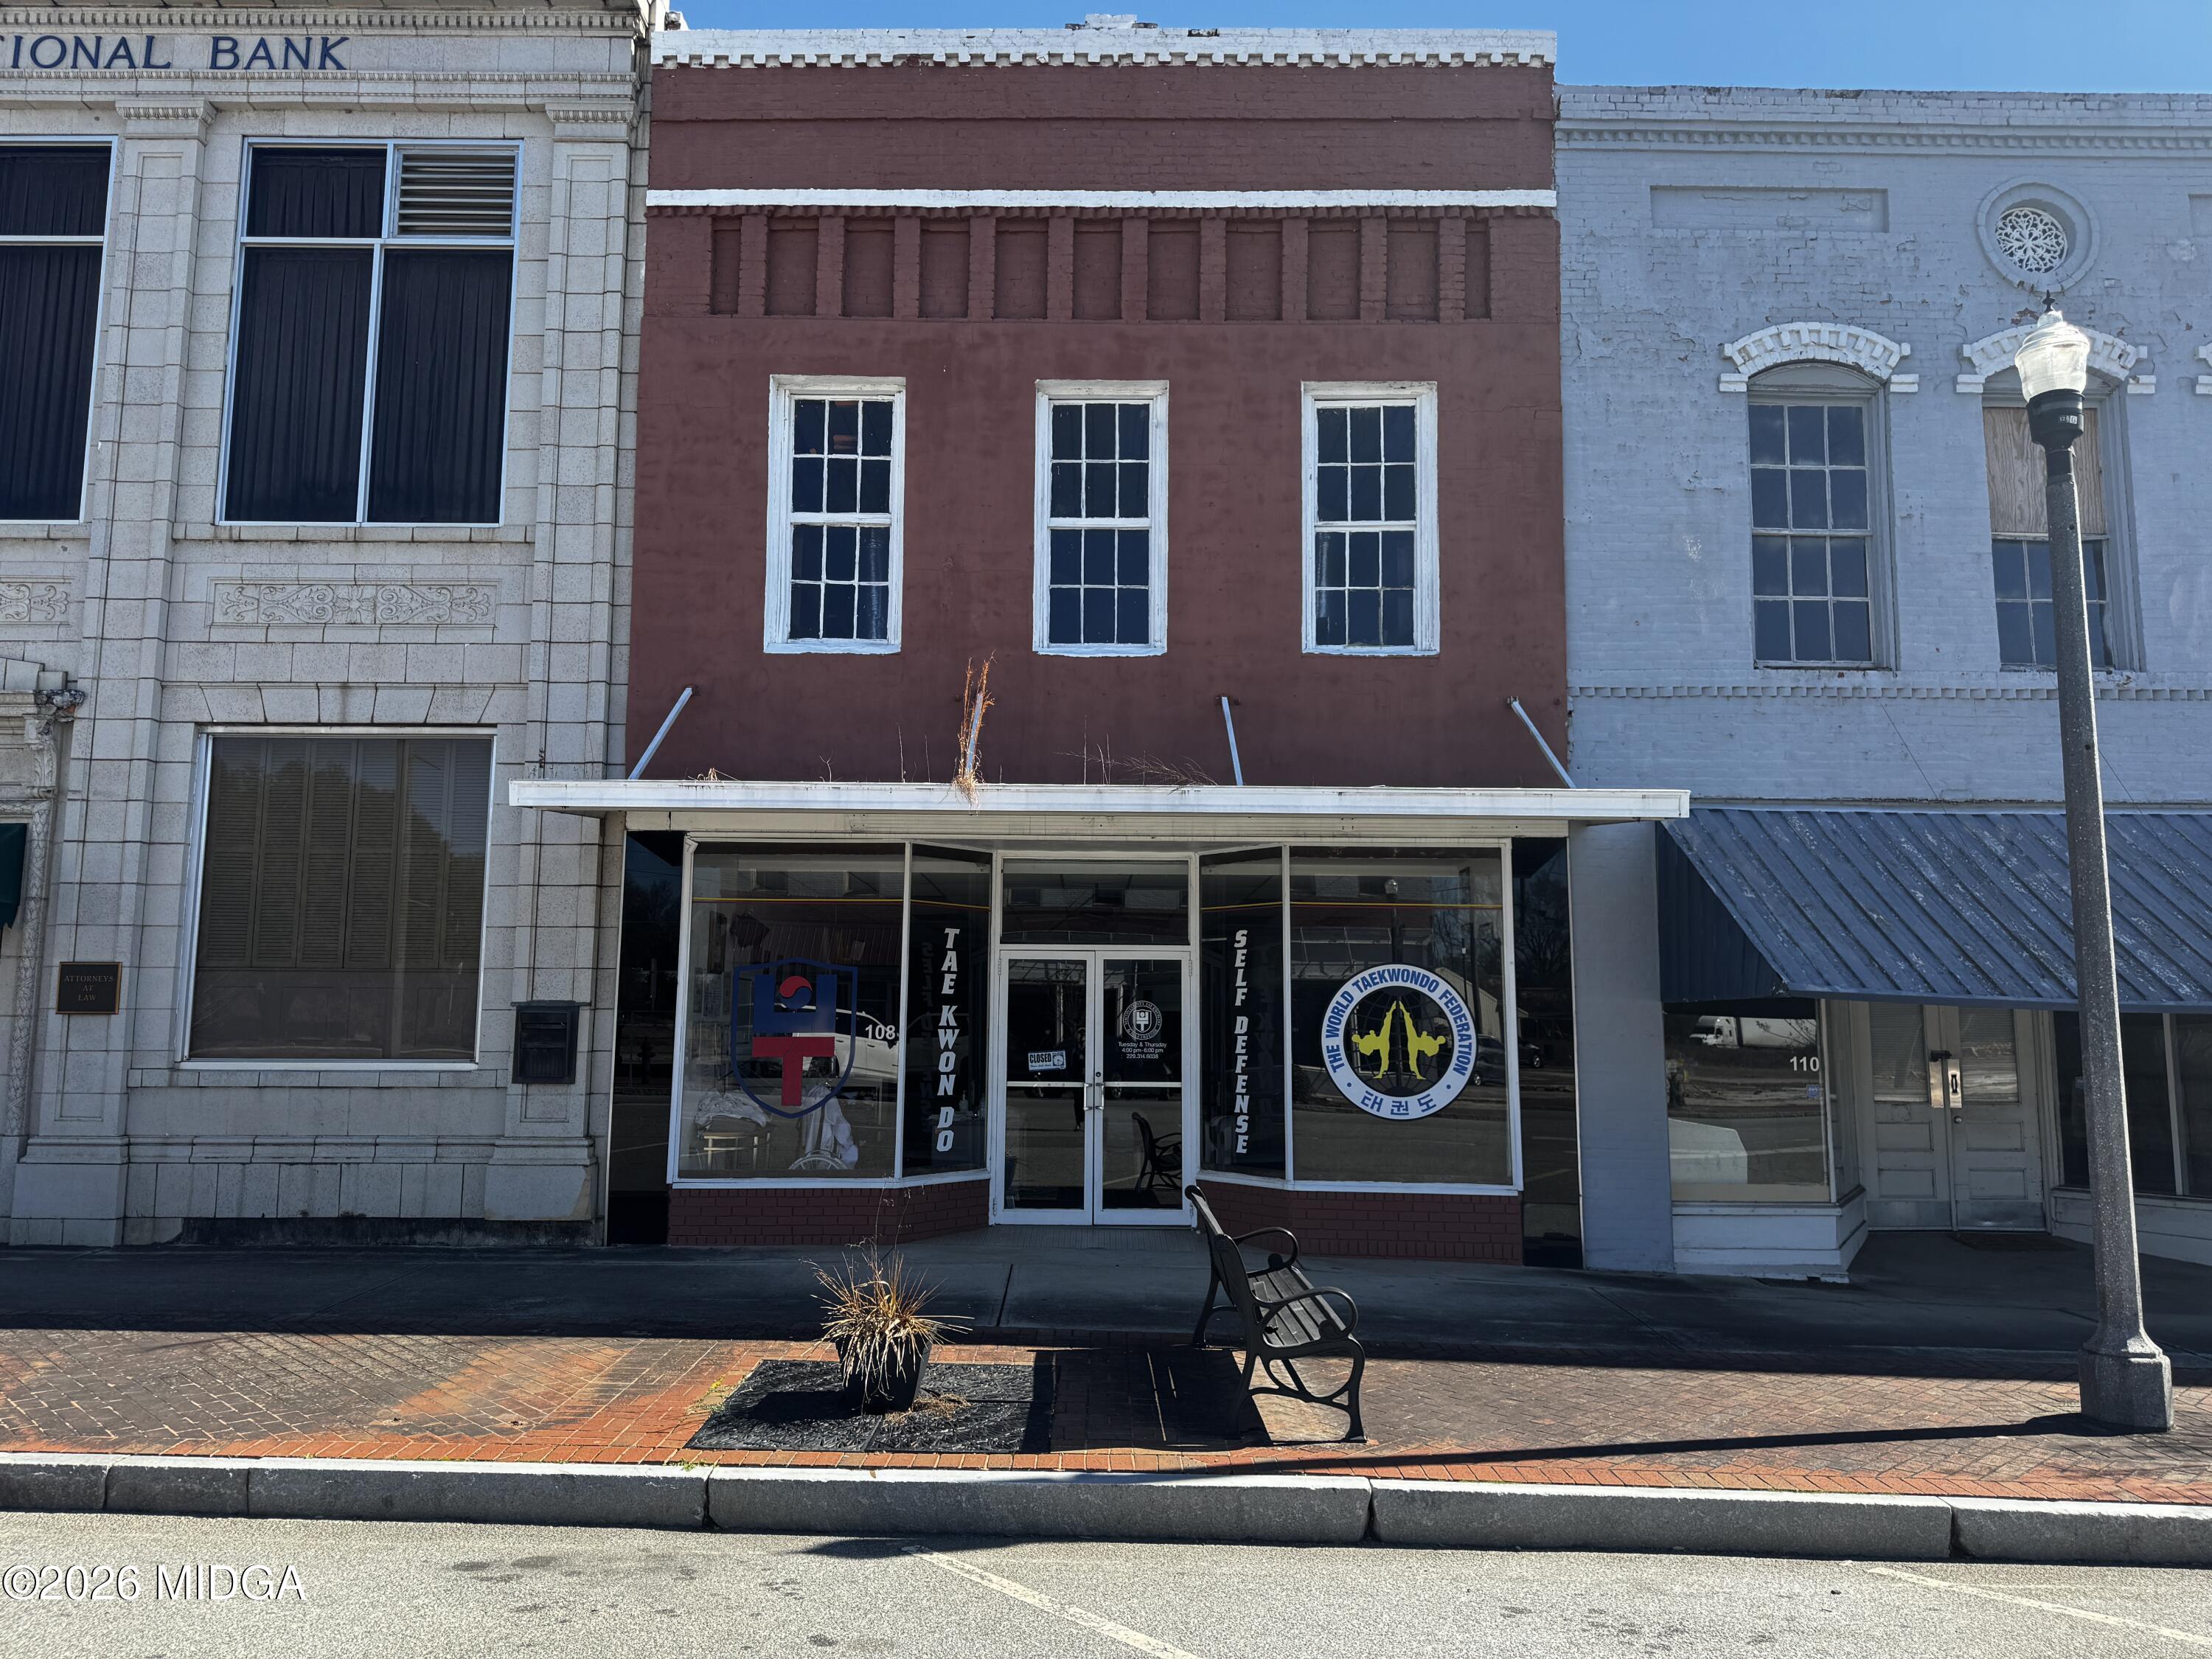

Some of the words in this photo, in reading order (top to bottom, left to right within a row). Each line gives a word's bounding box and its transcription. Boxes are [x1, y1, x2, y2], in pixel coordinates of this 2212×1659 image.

[0, 35, 171, 69] IONAL
[209, 36, 349, 69] BANK
[941, 928, 960, 995] TAE
[1234, 930, 1248, 1006] SELF
[1352, 968, 1440, 994] TAEKWONDO
[865, 1024, 896, 1040] 108
[1326, 990, 1354, 1038] WORLD
[1439, 989, 1472, 1077] FEDERATION
[937, 1005, 960, 1096] KWON
[1029, 1053, 1051, 1063] CLOSED
[1326, 1044, 1345, 1074] THE
[1790, 1056, 1820, 1071] 110
[1234, 1016, 1250, 1154] DEFENSE
[1360, 1090, 1437, 1116] 태권도
[936, 1107, 955, 1152] DO
